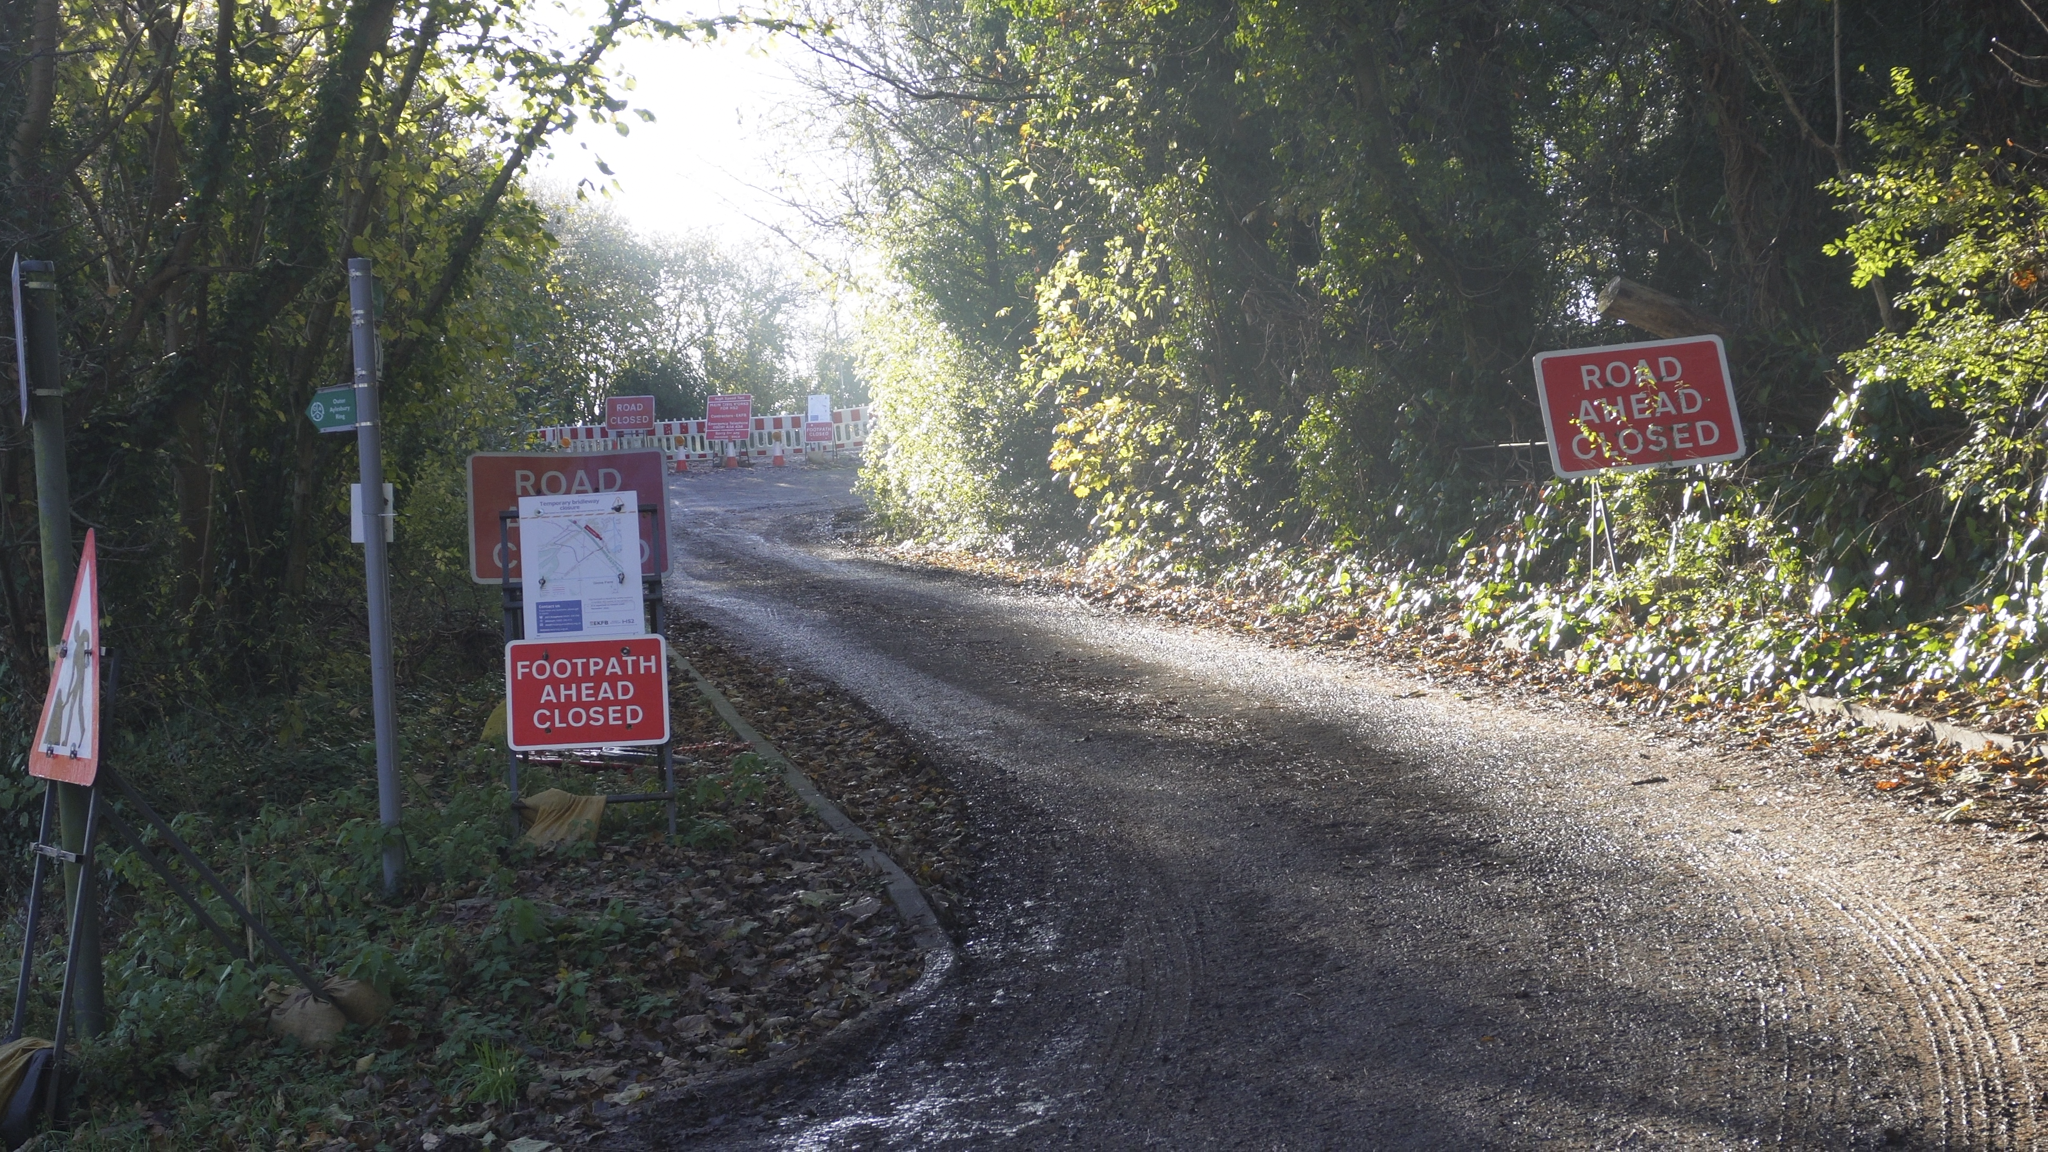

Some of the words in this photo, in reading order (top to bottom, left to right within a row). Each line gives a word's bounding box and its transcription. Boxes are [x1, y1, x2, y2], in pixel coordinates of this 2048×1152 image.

[1580, 356, 1682, 391] ROAD
[616, 403, 644, 412] ROAD
[1579, 388, 1703, 424] AHEAD
[610, 415, 649, 425] CLOSED
[1571, 420, 1720, 460] CLOSED
[515, 468, 622, 496] ROAD
[540, 500, 571, 508] Temporary
[572, 498, 600, 506] bridleway
[516, 655, 657, 680] FOOTPATH
[540, 680, 635, 704] AHEAD
[532, 704, 644, 729] CLOSED
